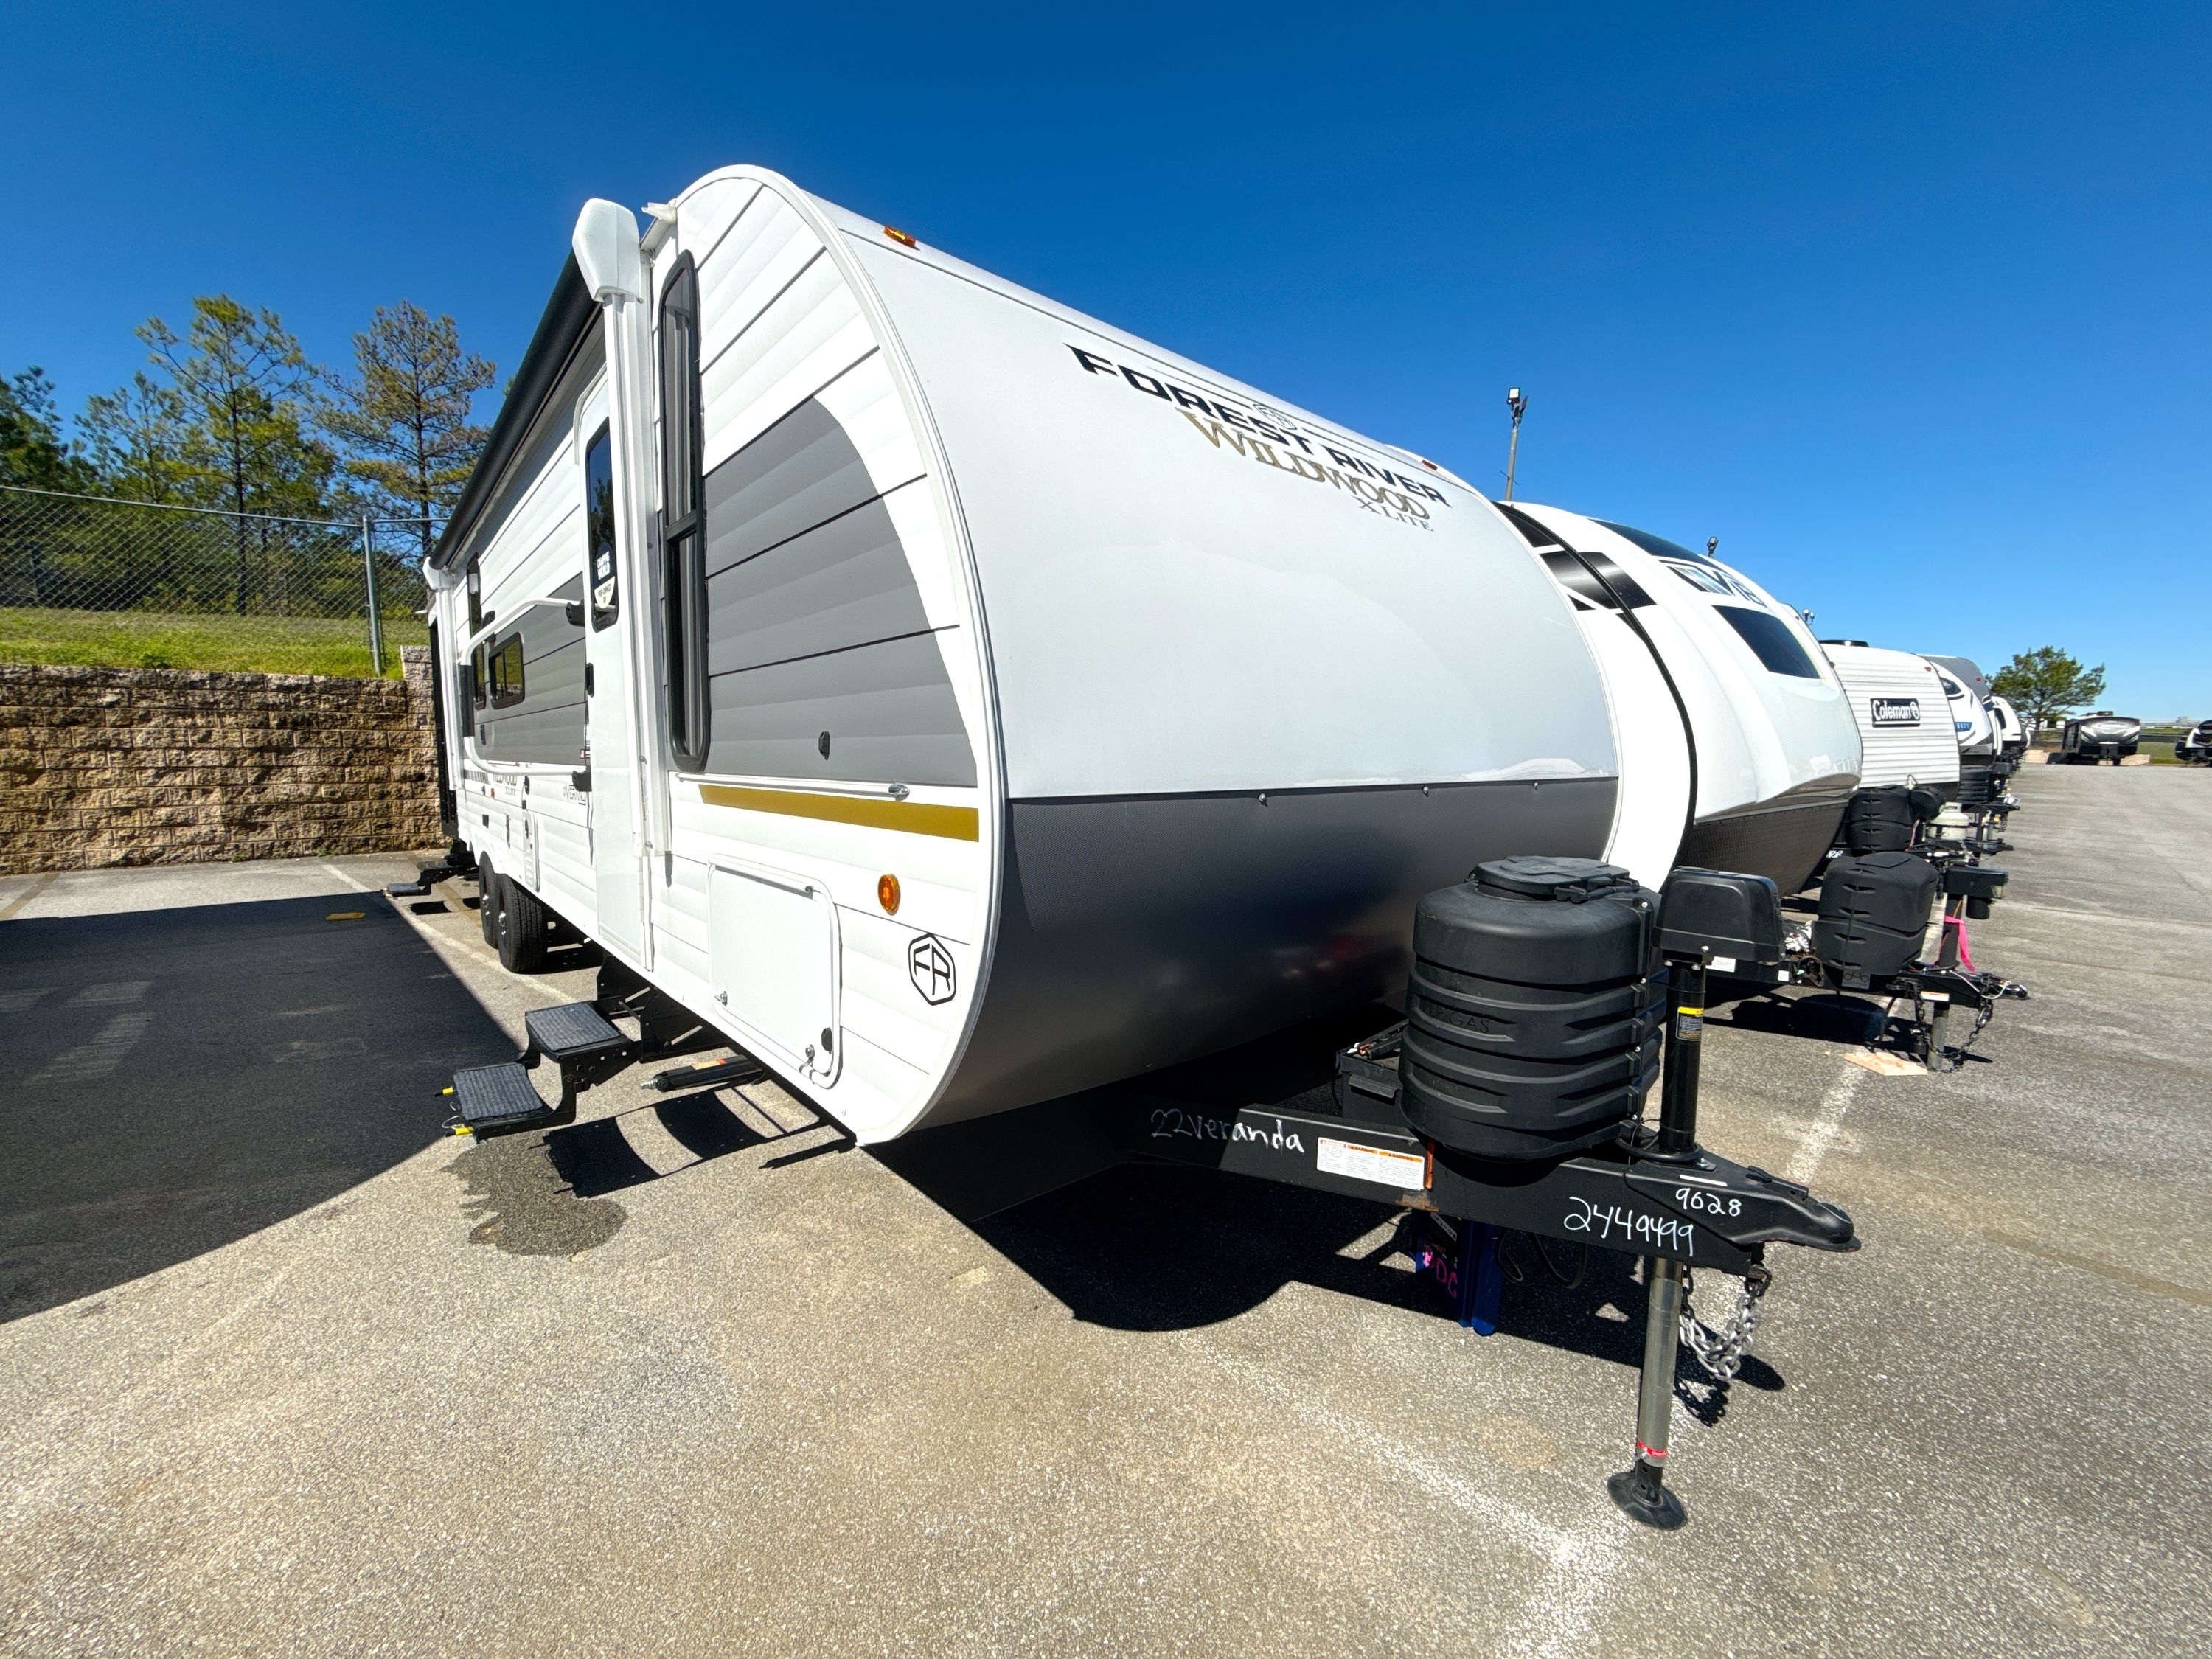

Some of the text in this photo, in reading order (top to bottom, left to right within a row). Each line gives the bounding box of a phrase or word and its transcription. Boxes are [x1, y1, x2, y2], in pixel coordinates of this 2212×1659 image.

[1062, 342, 1453, 508] FOREST RIVER
[1175, 407, 1430, 520] WILDWOOD
[1872, 700, 1912, 721] Coleman
[1450, 1012, 1490, 1034] GAS
[1675, 1188, 1742, 1217] 9628
[1564, 1197, 1694, 1257] 2449499
